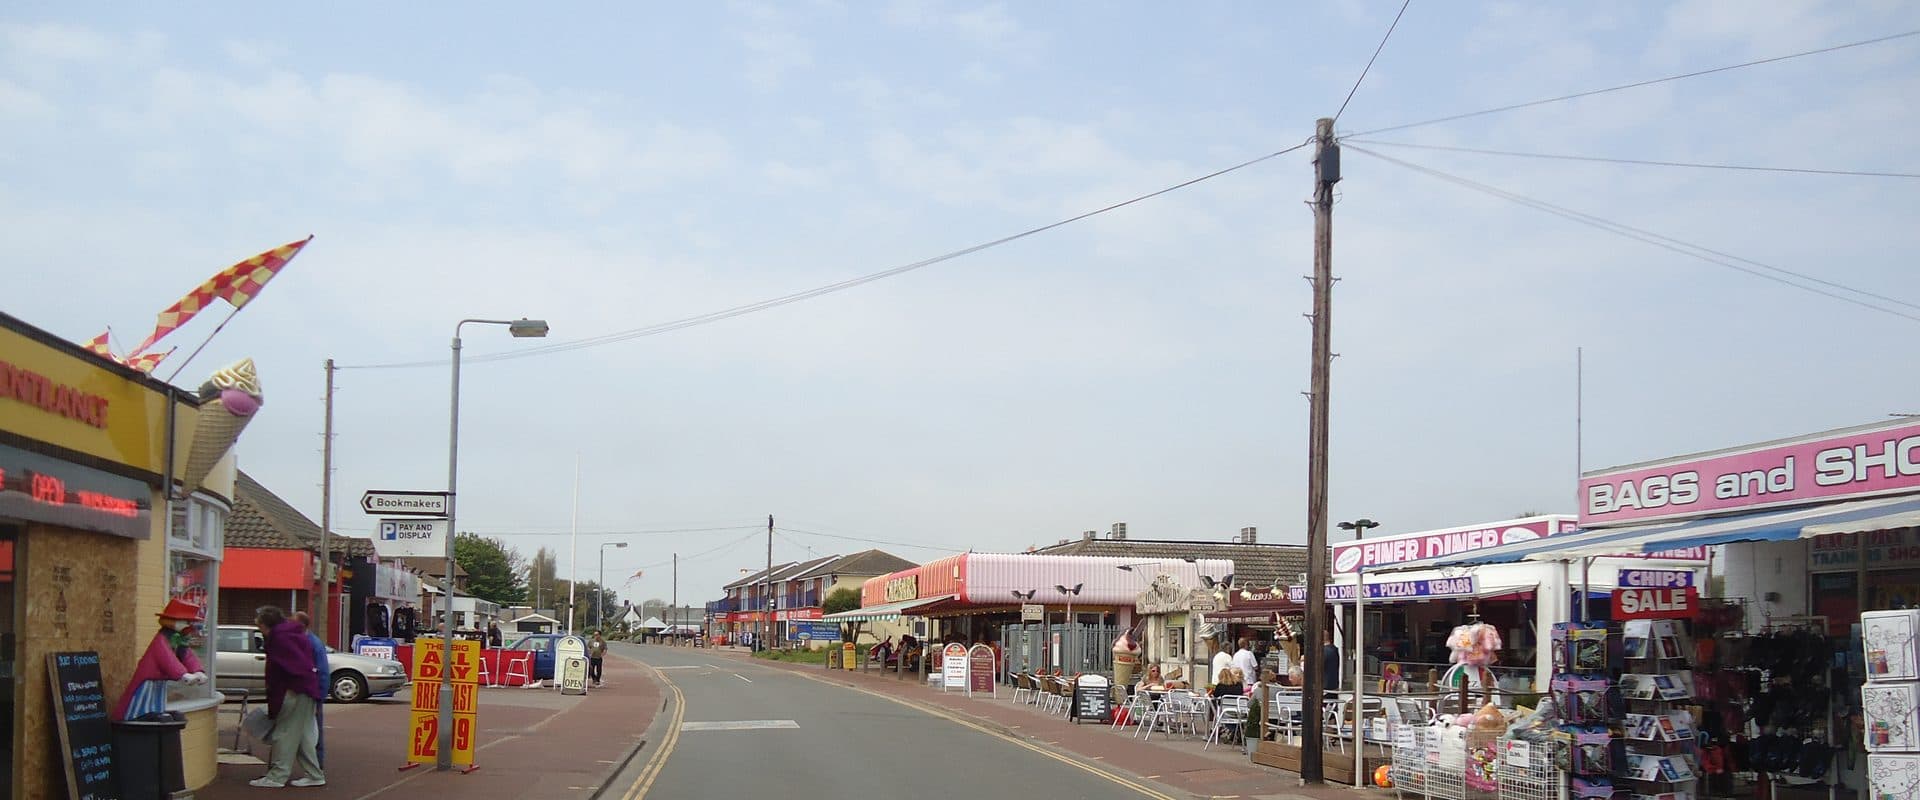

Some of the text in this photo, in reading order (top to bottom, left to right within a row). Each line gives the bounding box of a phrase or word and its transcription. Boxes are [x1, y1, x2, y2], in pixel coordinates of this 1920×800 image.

[1588, 471, 1700, 515] BAGS
[1715, 456, 1796, 500] and
[376, 498, 441, 508] Bookmakers
[399, 523, 433, 531] PAY AND
[399, 531, 432, 540] DISPLAY
[1363, 538, 1419, 565] FINER
[1627, 570, 1687, 588] CHIPS
[1291, 586, 1306, 600] HOT
[1380, 582, 1416, 597] PIZZAS
[1428, 578, 1470, 595] KEBABS
[1620, 588, 1688, 614] SALE
[422, 651, 470, 666] AL
[564, 679, 583, 689] OPEN
